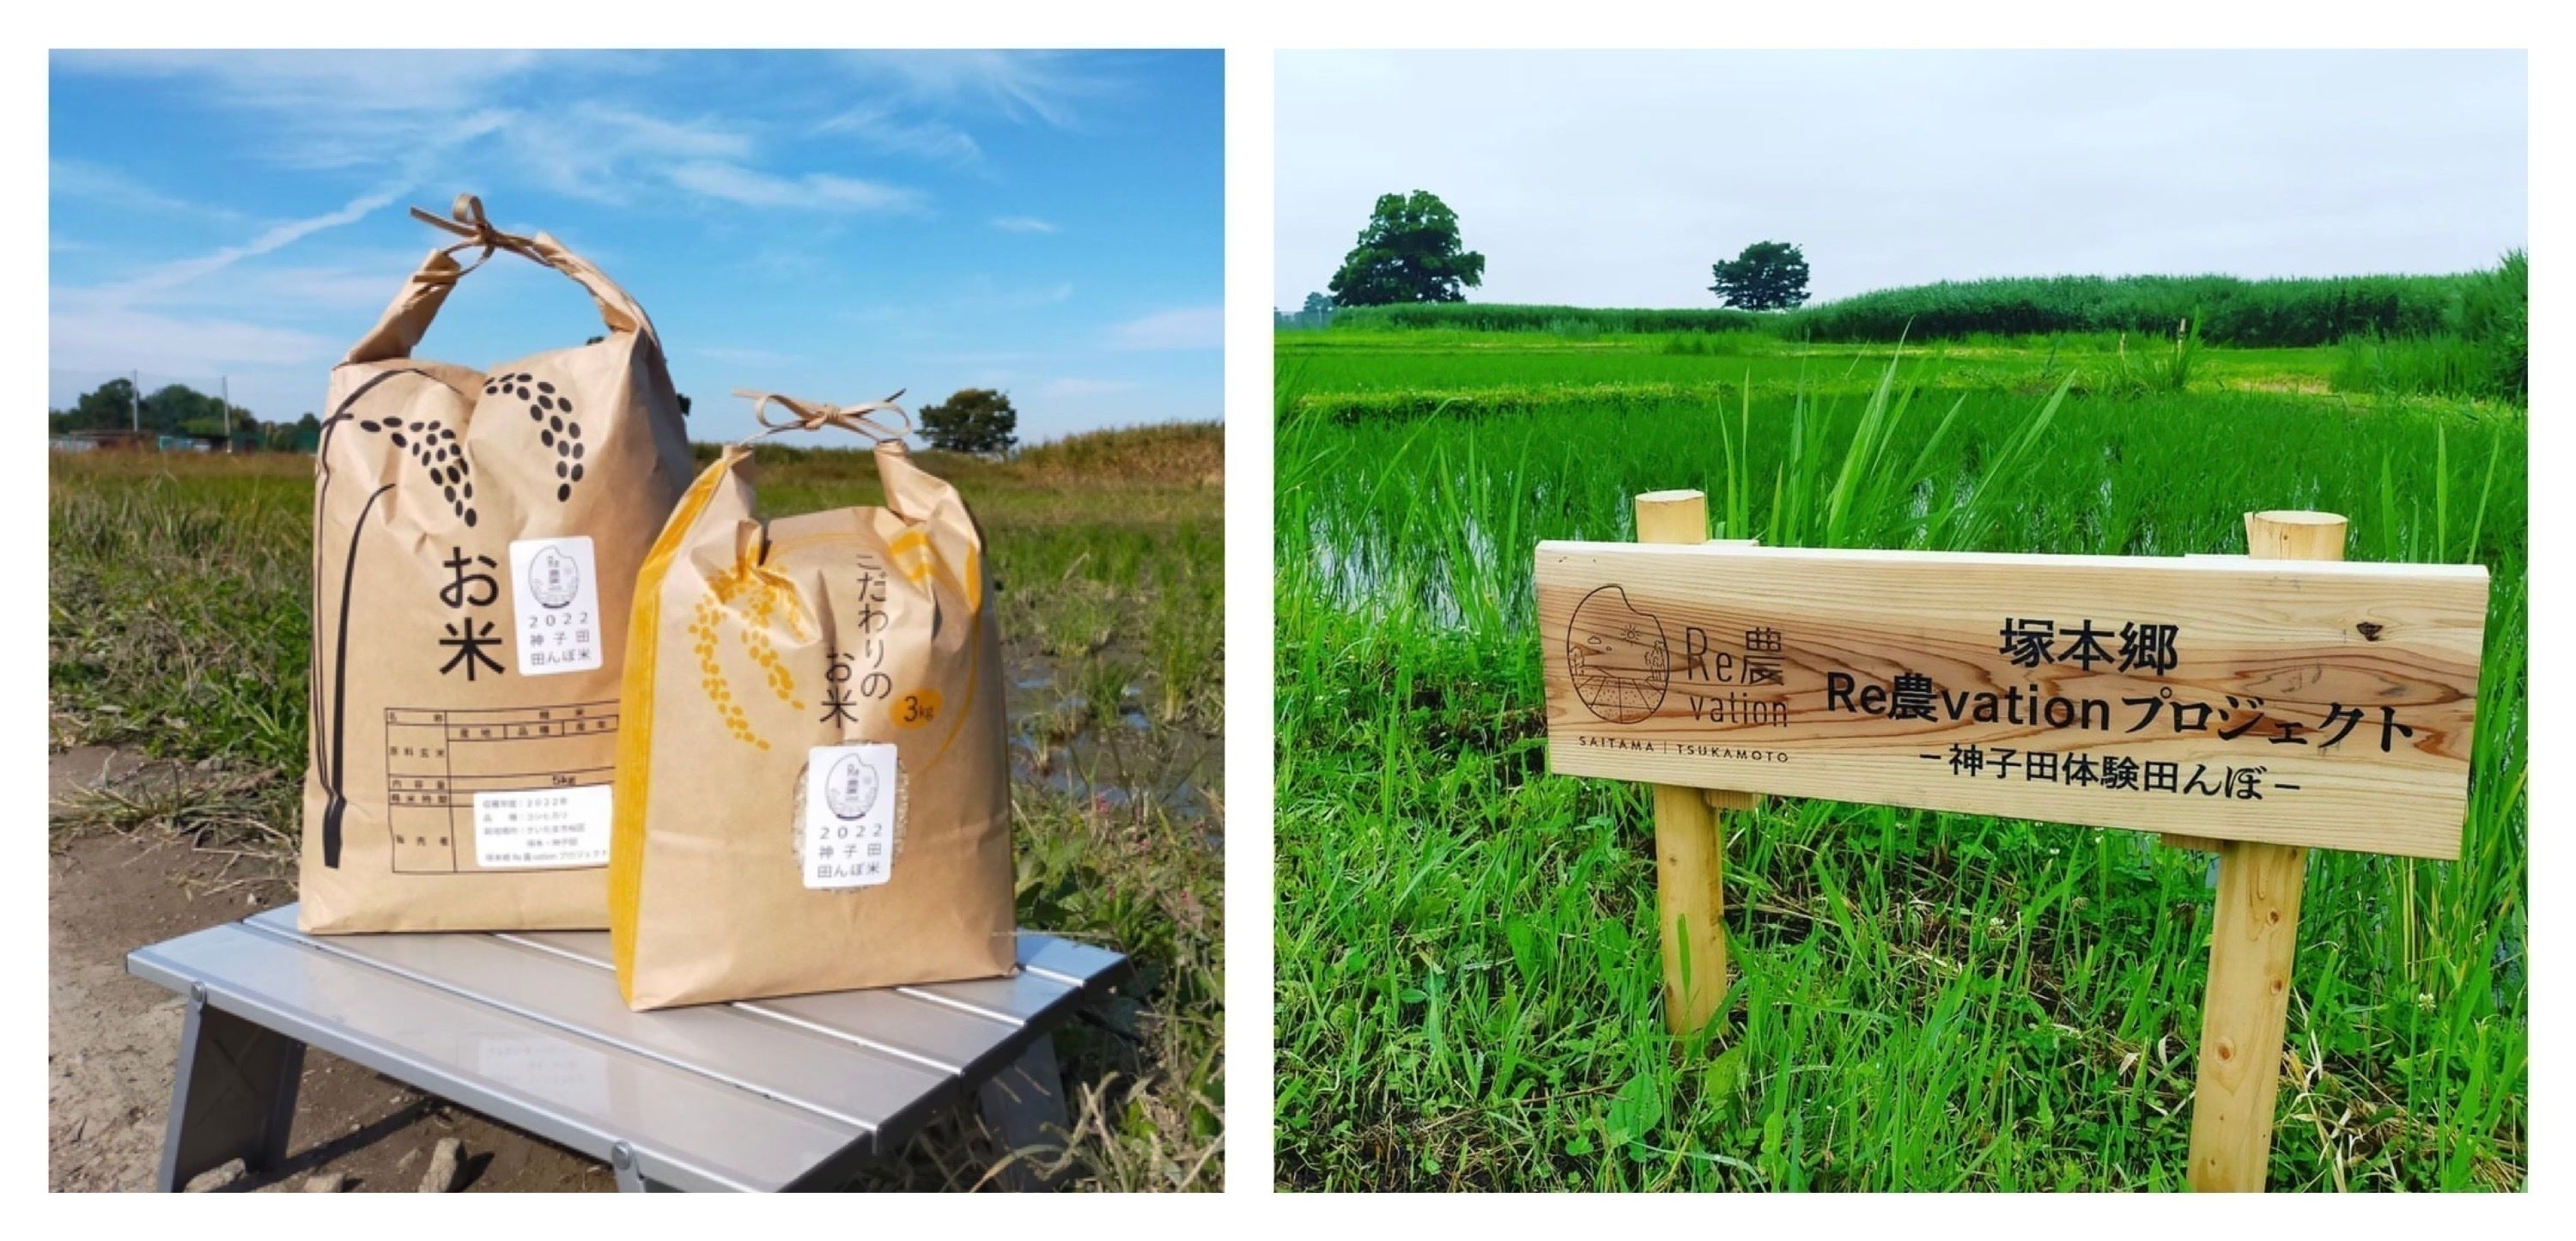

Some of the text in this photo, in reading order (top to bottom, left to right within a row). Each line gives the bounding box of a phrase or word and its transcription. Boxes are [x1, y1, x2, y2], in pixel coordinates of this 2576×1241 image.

[438, 546, 506, 681] お米
[529, 611, 588, 629] 2022
[856, 553, 893, 700] こだわりの
[1999, 617, 2179, 676] 塚本郷
[820, 646, 859, 729] お米
[903, 696, 934, 722] 3kg
[1689, 691, 1788, 727] vation
[1578, 736, 1789, 763] SAITAMA TSUKAMOTO
[819, 823, 882, 840] 2022
[817, 861, 880, 879] 田んぼ米
